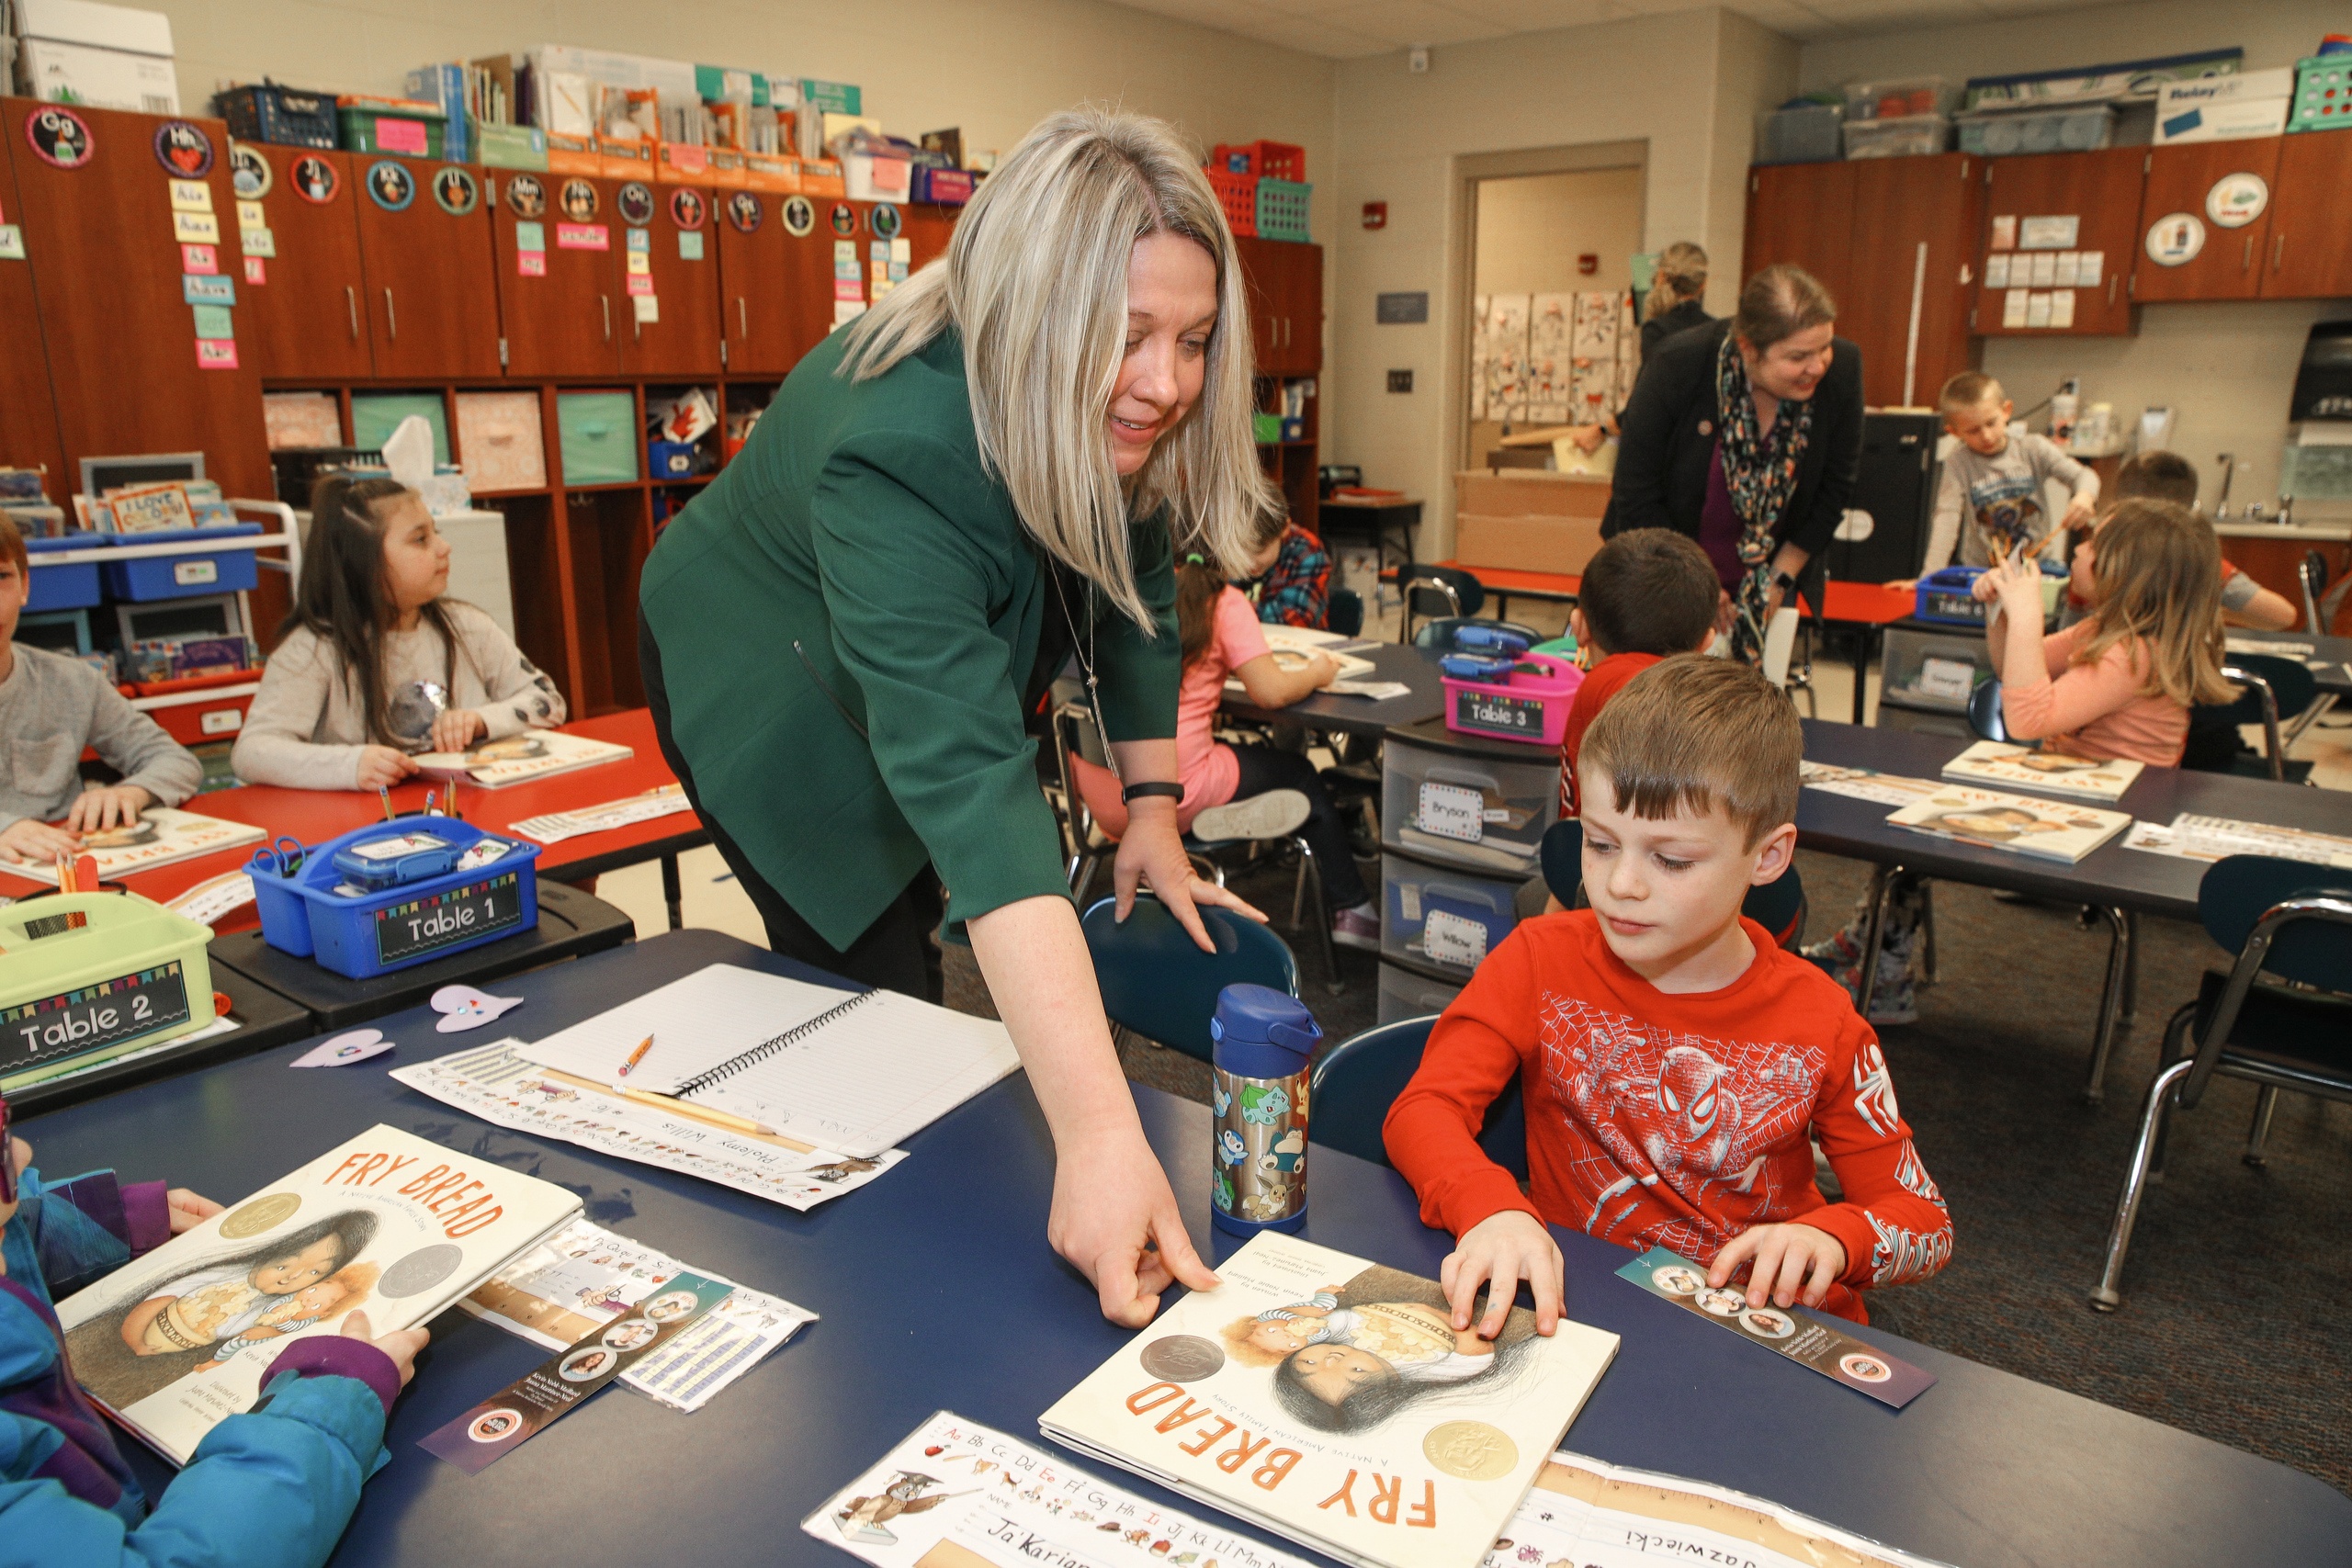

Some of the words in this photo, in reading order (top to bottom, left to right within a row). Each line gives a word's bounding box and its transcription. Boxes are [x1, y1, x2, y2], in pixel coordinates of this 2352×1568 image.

[41, 111, 75, 138] Gg
[170, 126, 196, 146] Hh
[304, 157, 321, 180] Jj
[379, 165, 400, 183] Kk
[514, 177, 539, 196] Mm
[571, 181, 591, 197] Nn
[1938, 600, 1973, 616] Table
[1472, 702, 1512, 725] Table
[1517, 711, 1527, 727] 3
[1432, 801, 1470, 821] Bryson
[408, 905, 476, 942] Table
[484, 897, 495, 919] 1
[20, 1007, 119, 1053] Table
[131, 993, 153, 1021] 2
[661, 1122, 707, 1144] Willis
[716, 1139, 779, 1167] Ptolemy
[322, 1153, 420, 1187] FRY
[396, 1163, 503, 1240] BREAD
[1227, 1270, 1255, 1284] Maillard
[1258, 1280, 1280, 1292] Noble
[1252, 1286, 1279, 1298] Written
[1283, 1288, 1305, 1299] Kevin
[1125, 1381, 1305, 1492] BREAD
[944, 1428, 961, 1441] Aa
[967, 1435, 984, 1449] Bb
[991, 1444, 1007, 1458] Cc
[1014, 1454, 1036, 1472] Dd
[1038, 1467, 1056, 1483] Ee
[1063, 1480, 1085, 1495] Ff
[1088, 1491, 1108, 1511] Gg
[1115, 1502, 1135, 1517] Hh
[1143, 1512, 1161, 1526] Ii
[1168, 1522, 1186, 1540] Jj
[1190, 1531, 1209, 1548] Kk
[1233, 1547, 1261, 1568] Mm
[987, 1494, 1013, 1510] NAME
[1317, 1469, 1437, 1529] FRY
